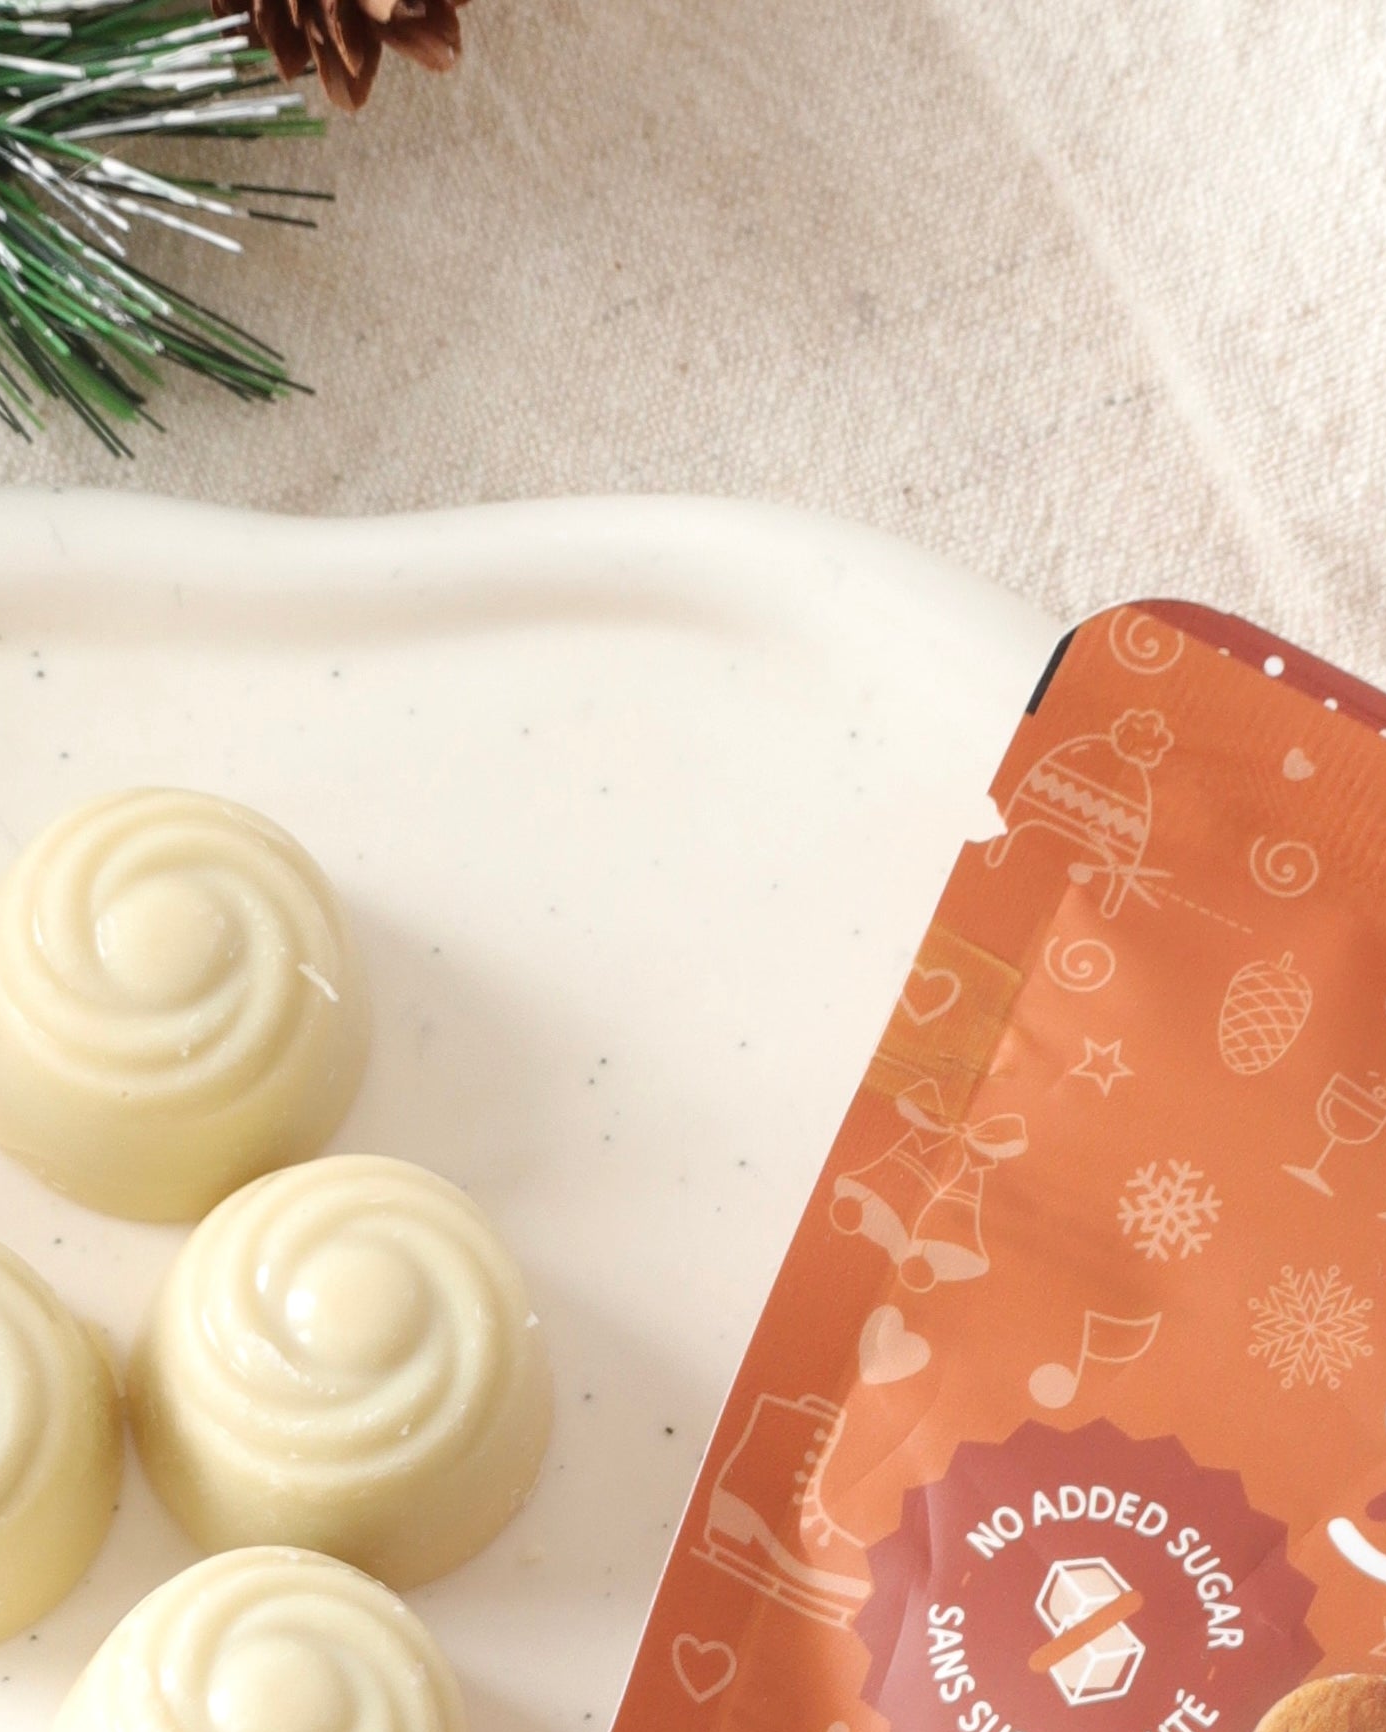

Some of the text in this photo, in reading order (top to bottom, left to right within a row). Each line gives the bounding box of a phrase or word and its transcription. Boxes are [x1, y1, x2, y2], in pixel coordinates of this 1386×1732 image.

[966, 1485, 1245, 1649] NO ADDED SUGAR
[926, 1604, 975, 1702] SANS
